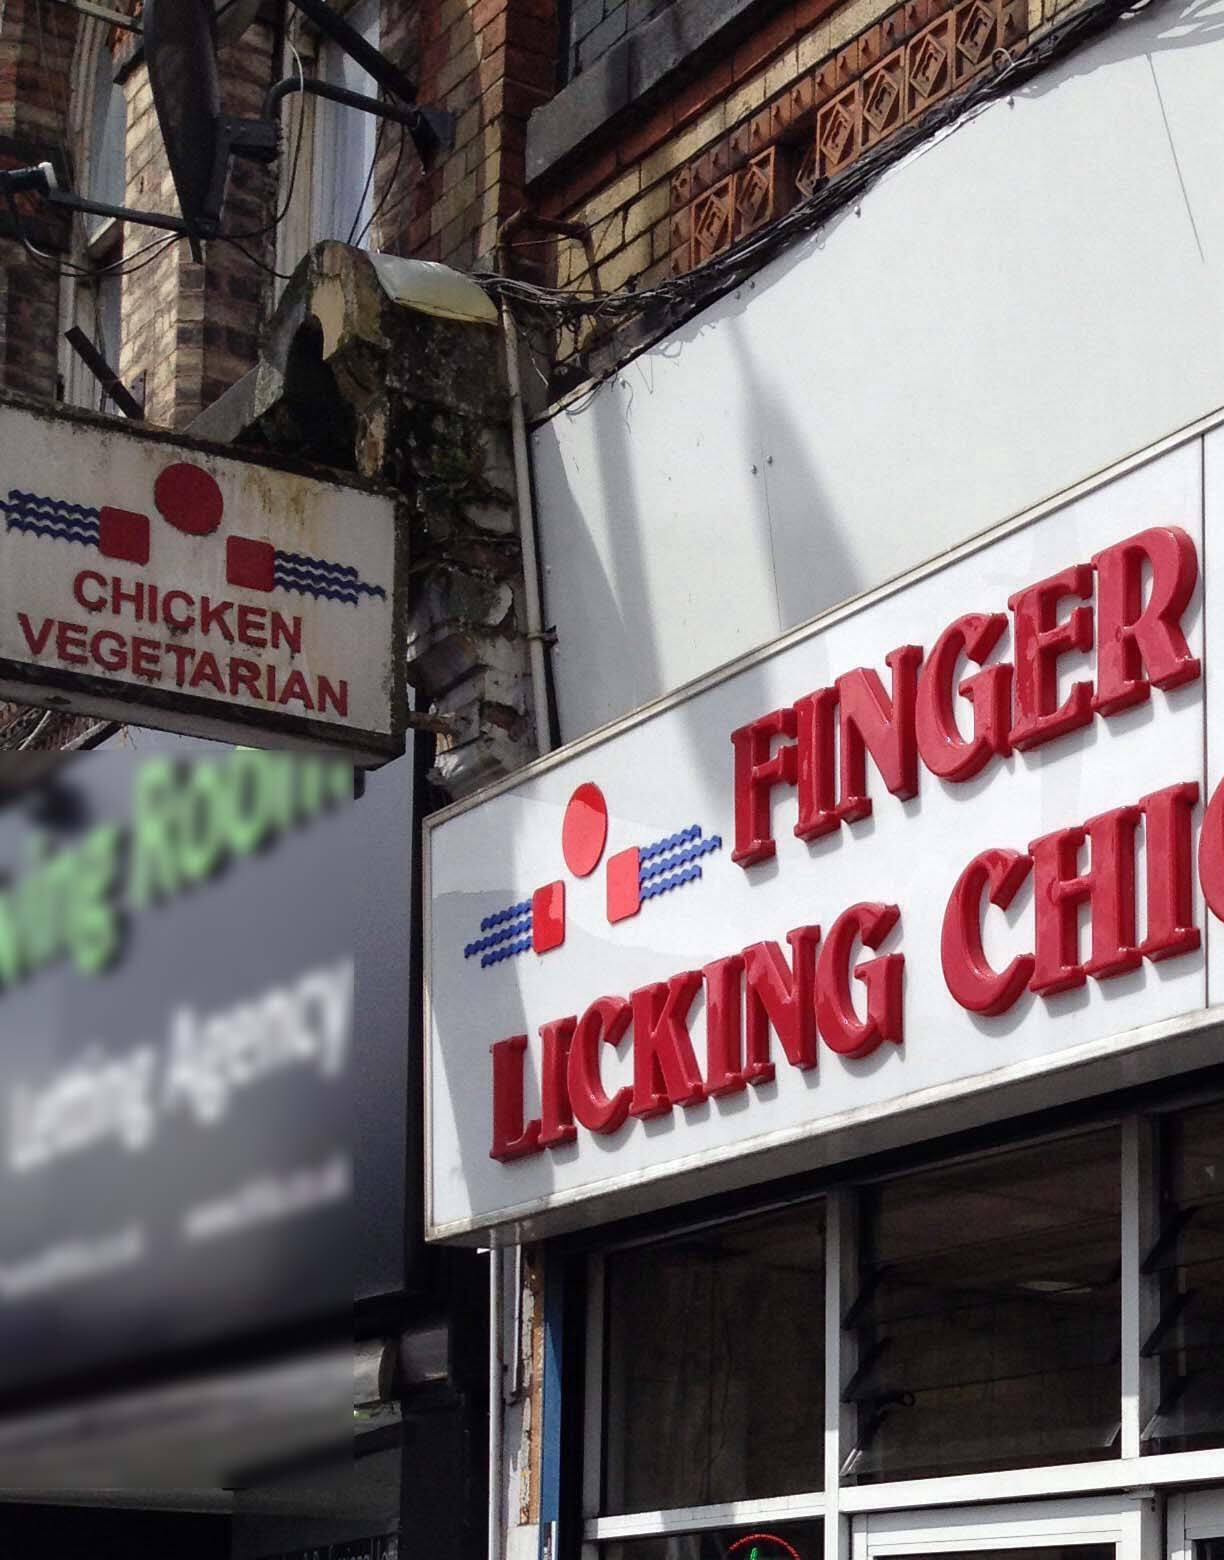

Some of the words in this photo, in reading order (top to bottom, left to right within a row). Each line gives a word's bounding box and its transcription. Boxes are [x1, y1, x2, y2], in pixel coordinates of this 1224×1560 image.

[17, 612, 349, 717] VEGETARIAN
[73, 570, 303, 654] CHICKEN
[730, 524, 1201, 870] FINGER
[488, 901, 906, 1164] LICKING
